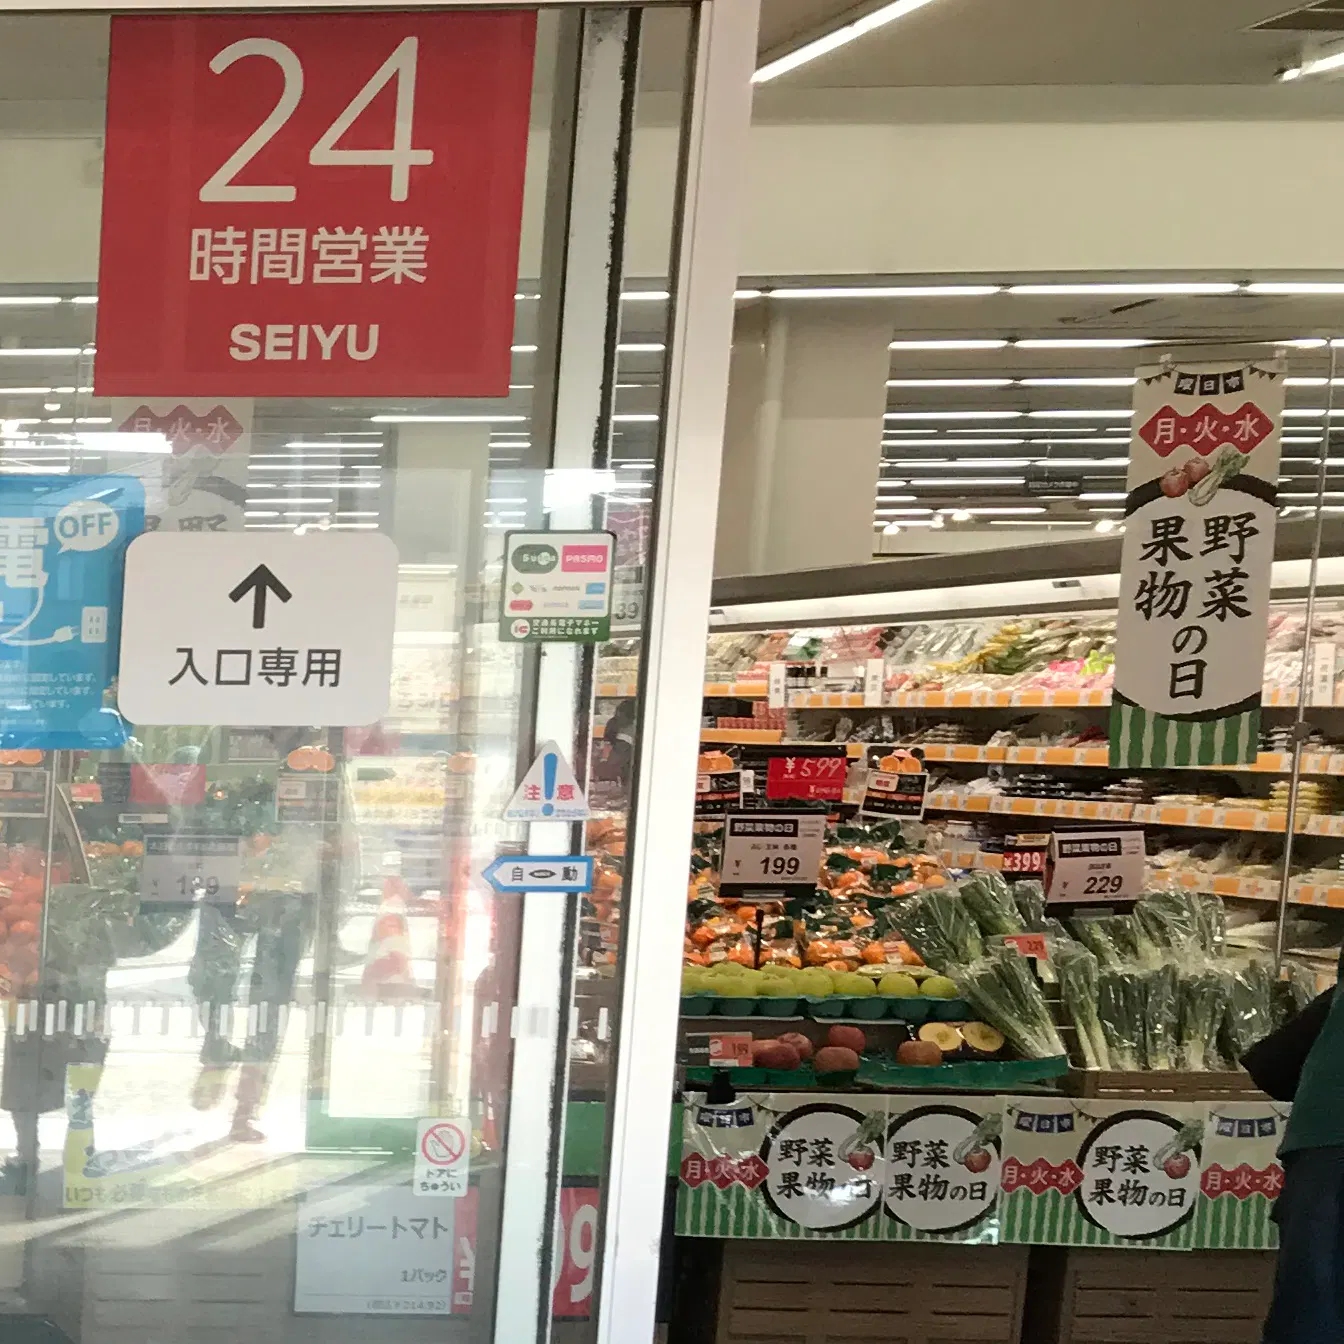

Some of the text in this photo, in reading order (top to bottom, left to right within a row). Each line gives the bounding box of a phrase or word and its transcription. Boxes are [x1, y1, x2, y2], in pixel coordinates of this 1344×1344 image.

[199, 37, 433, 201] 24
[189, 226, 430, 286] 時間営業
[230, 323, 378, 360] SEIYU
[1154, 414, 1261, 446] 月・火・水
[57, 512, 112, 539] OFF
[1134, 514, 1193, 620] 果物
[1197, 511, 1261, 622] 野菜
[168, 646, 342, 688] 入口専用
[760, 856, 800, 875] 199
[1083, 875, 1123, 894] 229
[778, 1138, 835, 1167] 野菜
[892, 1139, 950, 1169] 野菜
[1095, 1145, 1150, 1174] 野菜
[777, 1172, 872, 1200] 果物日
[889, 1173, 986, 1201] 果物の日
[1088, 1178, 1186, 1208] 果物の日
[307, 1217, 448, 1240] チェリートマト
